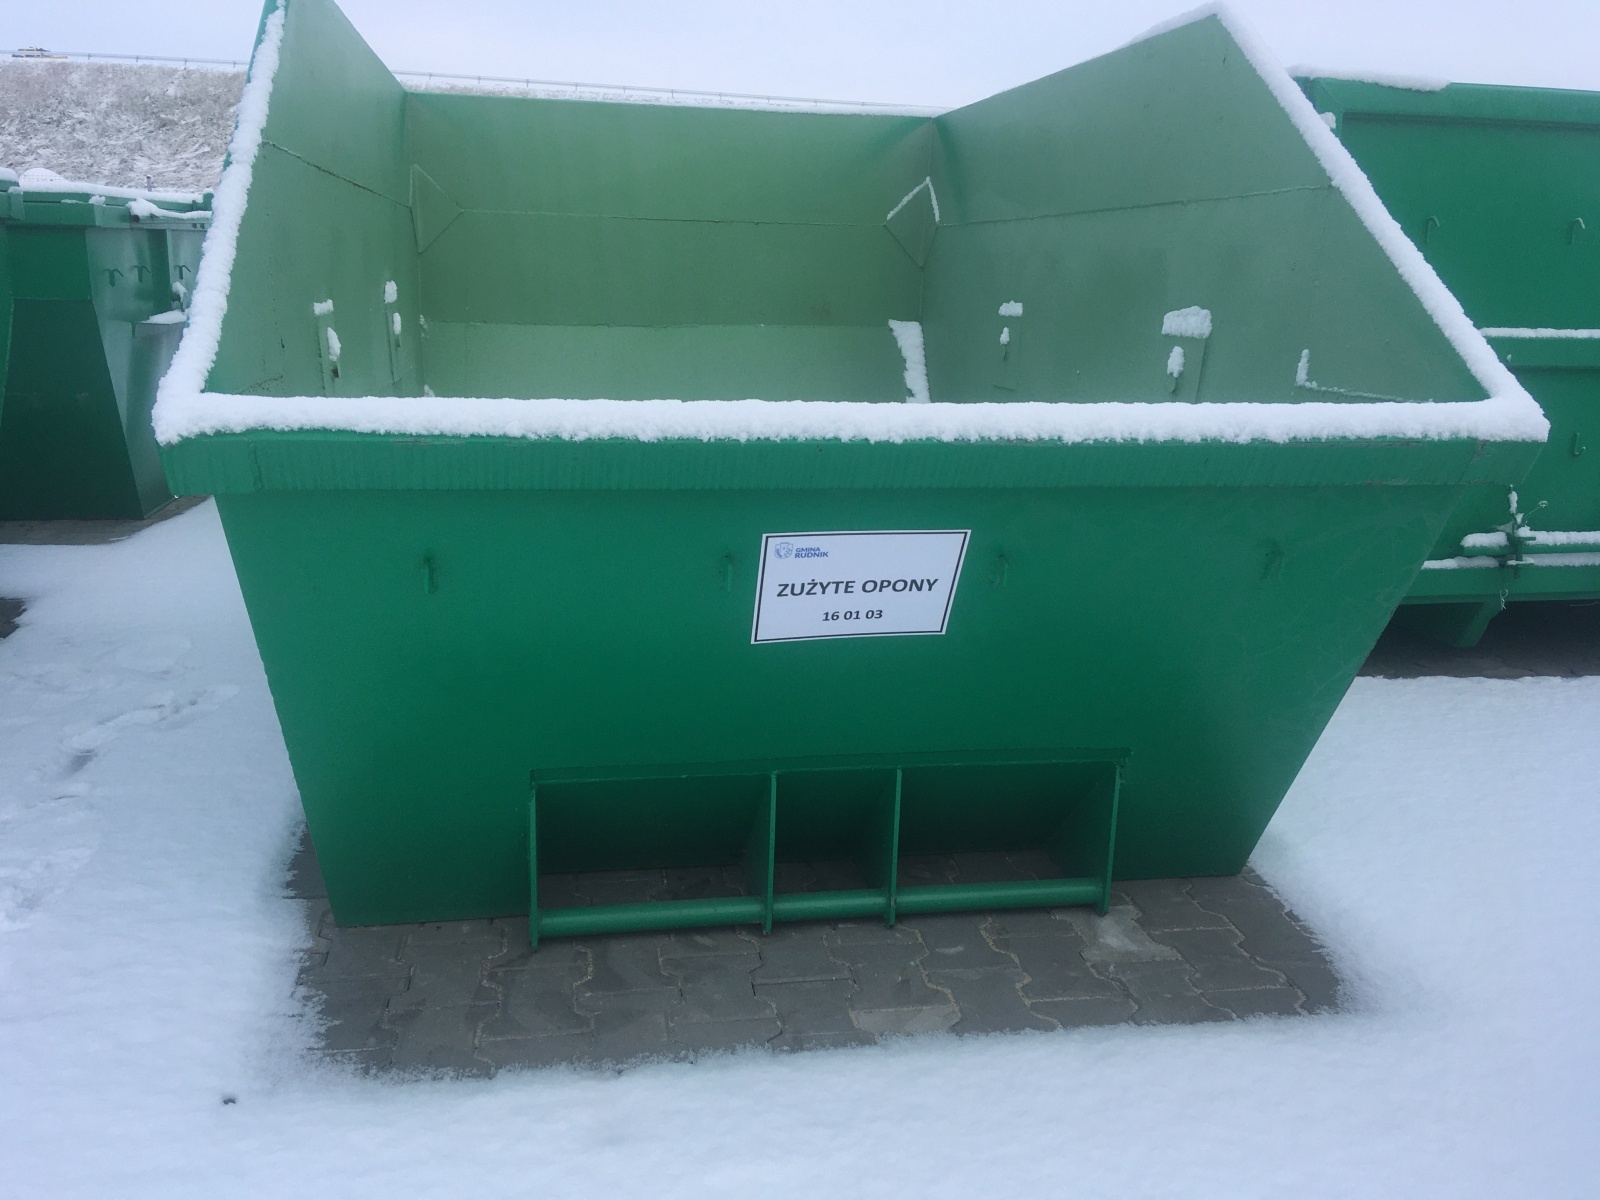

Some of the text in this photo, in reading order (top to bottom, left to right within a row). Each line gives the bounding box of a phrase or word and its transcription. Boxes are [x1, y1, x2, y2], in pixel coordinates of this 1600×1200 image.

[794, 551, 829, 559] RUDNIK
[776, 578, 939, 597] ZUŻYTE OPONY
[822, 609, 883, 621] 16 01 03
